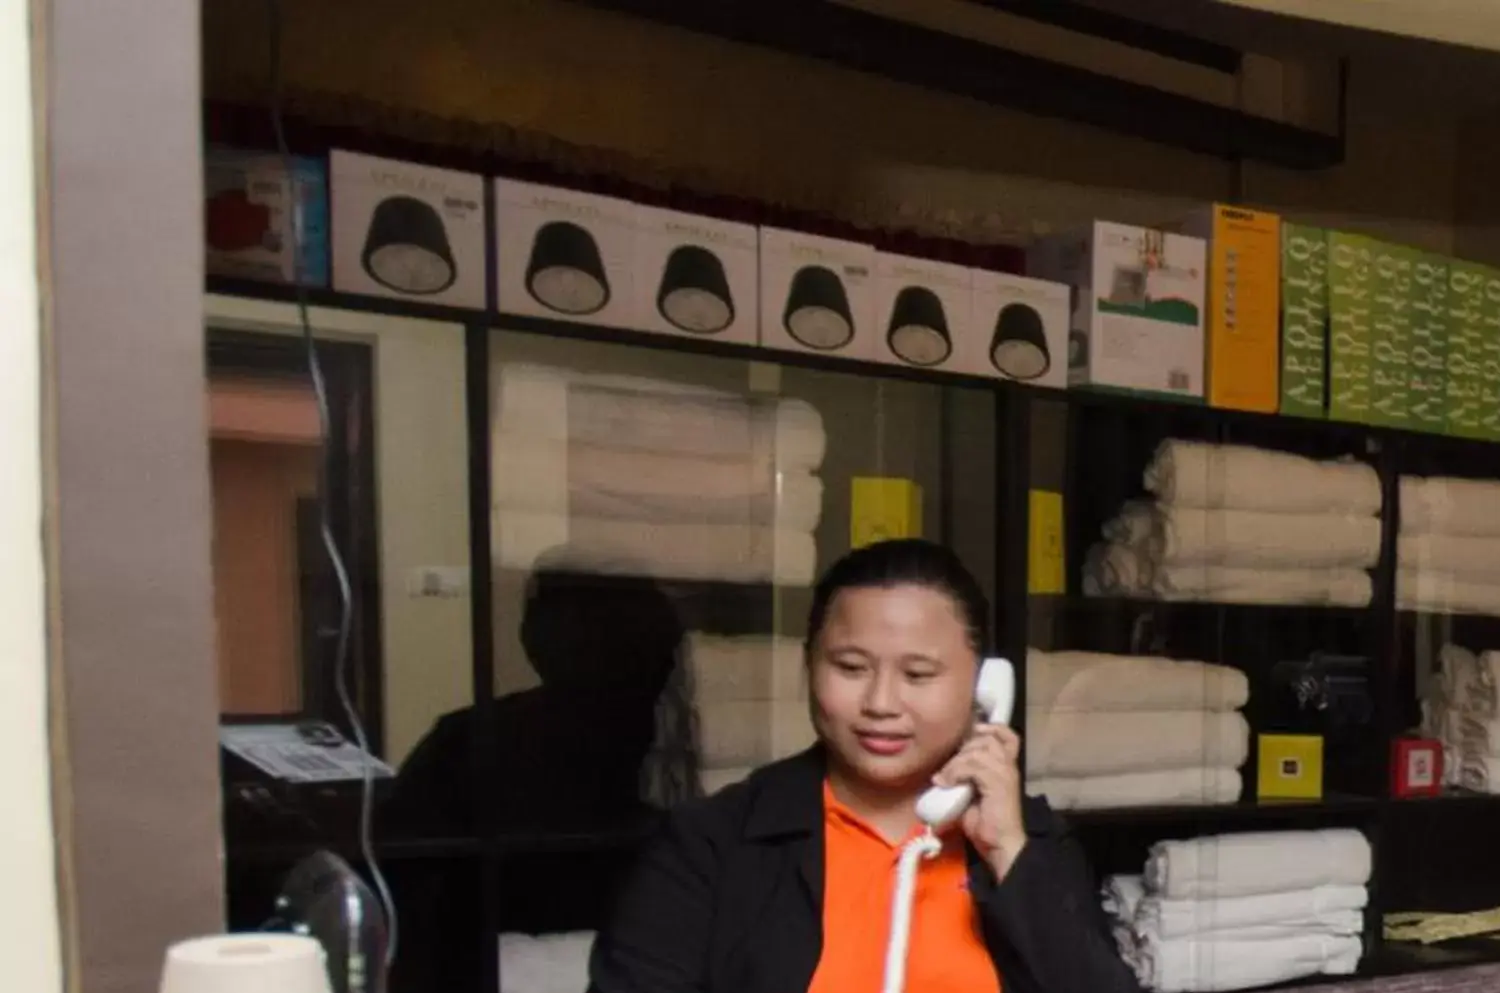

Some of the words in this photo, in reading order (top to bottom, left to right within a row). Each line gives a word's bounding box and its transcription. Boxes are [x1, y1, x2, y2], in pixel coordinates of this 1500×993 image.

[1284, 237, 1310, 402] APOLLO
[1332, 244, 1352, 407] APOLLO
[1373, 254, 1394, 413] APOLLO
[1410, 262, 1432, 419] APOLLO
[1446, 271, 1469, 424] APOLLO
